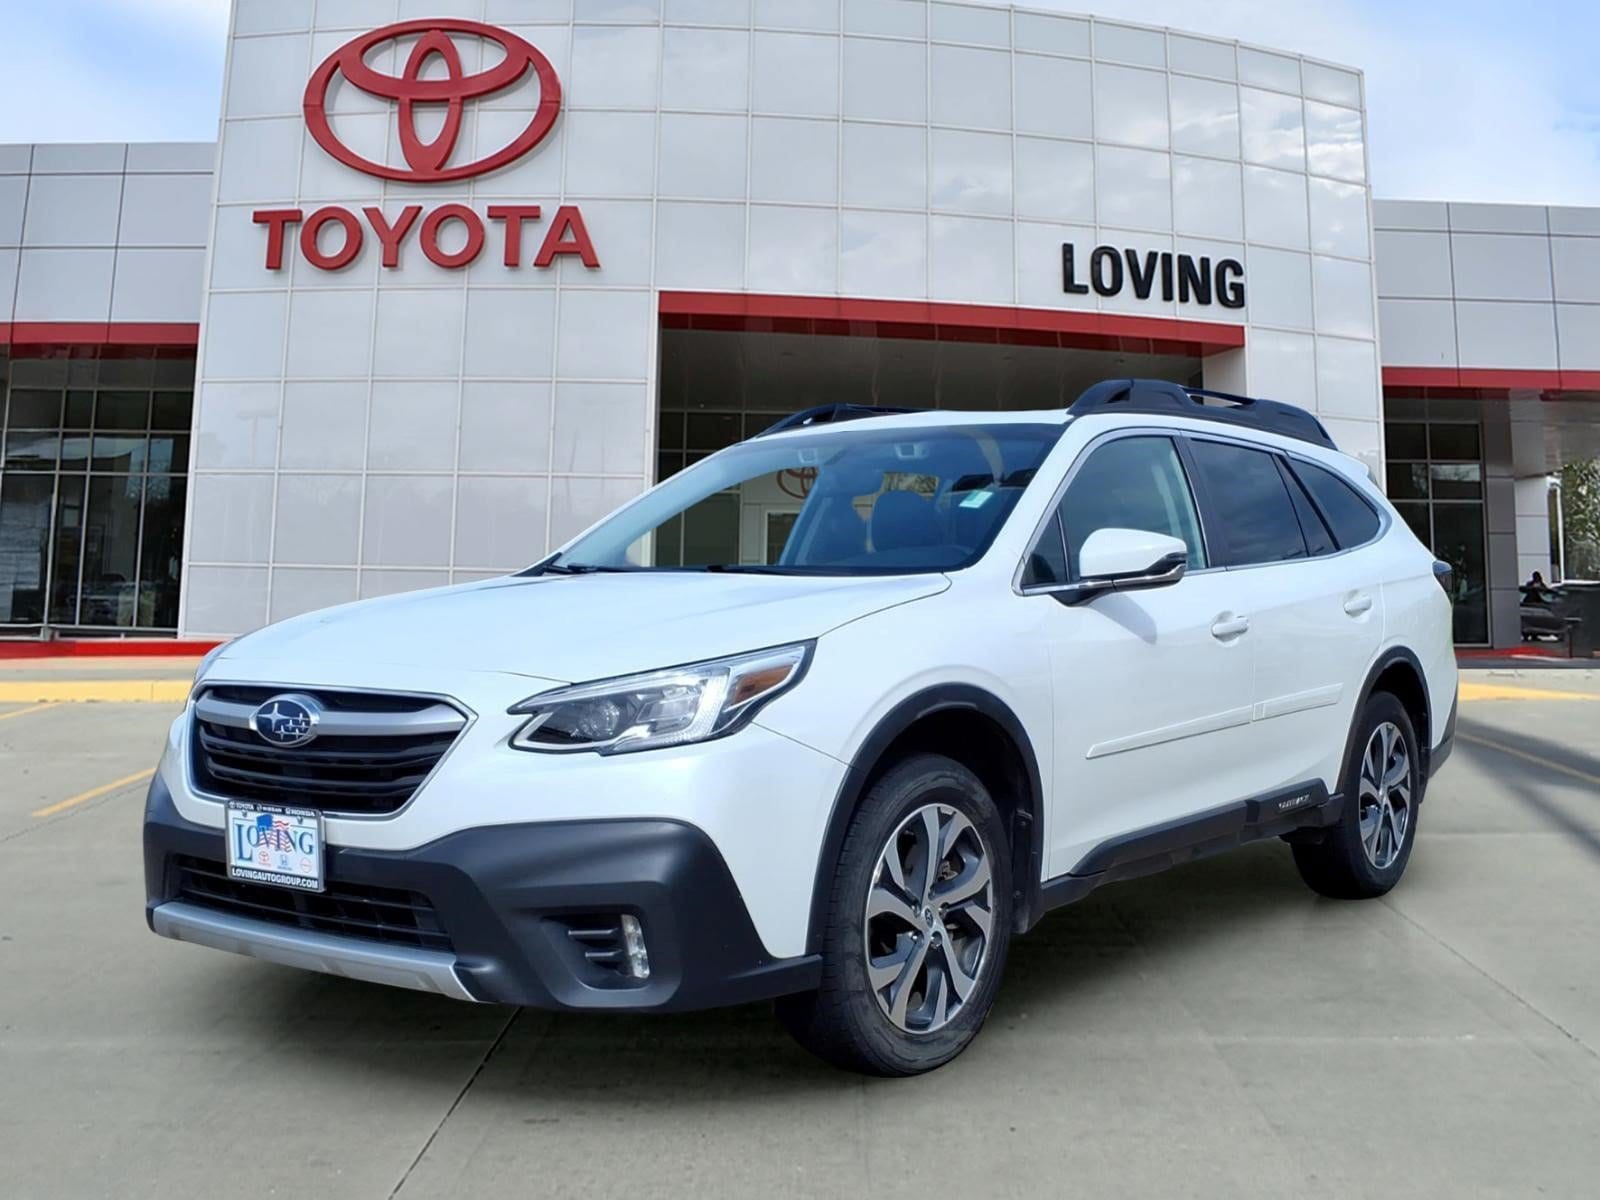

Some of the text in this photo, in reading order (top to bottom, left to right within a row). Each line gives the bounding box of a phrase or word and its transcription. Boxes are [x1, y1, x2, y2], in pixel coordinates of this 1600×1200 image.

[253, 203, 601, 271] TOYOTA
[1062, 243, 1246, 309] LOVING
[236, 802, 254, 810] TOYOTA
[291, 809, 315, 817] HONDA
[236, 823, 314, 862] LOVING
[232, 867, 319, 889] LOVINGAUTOGROUP.COM
